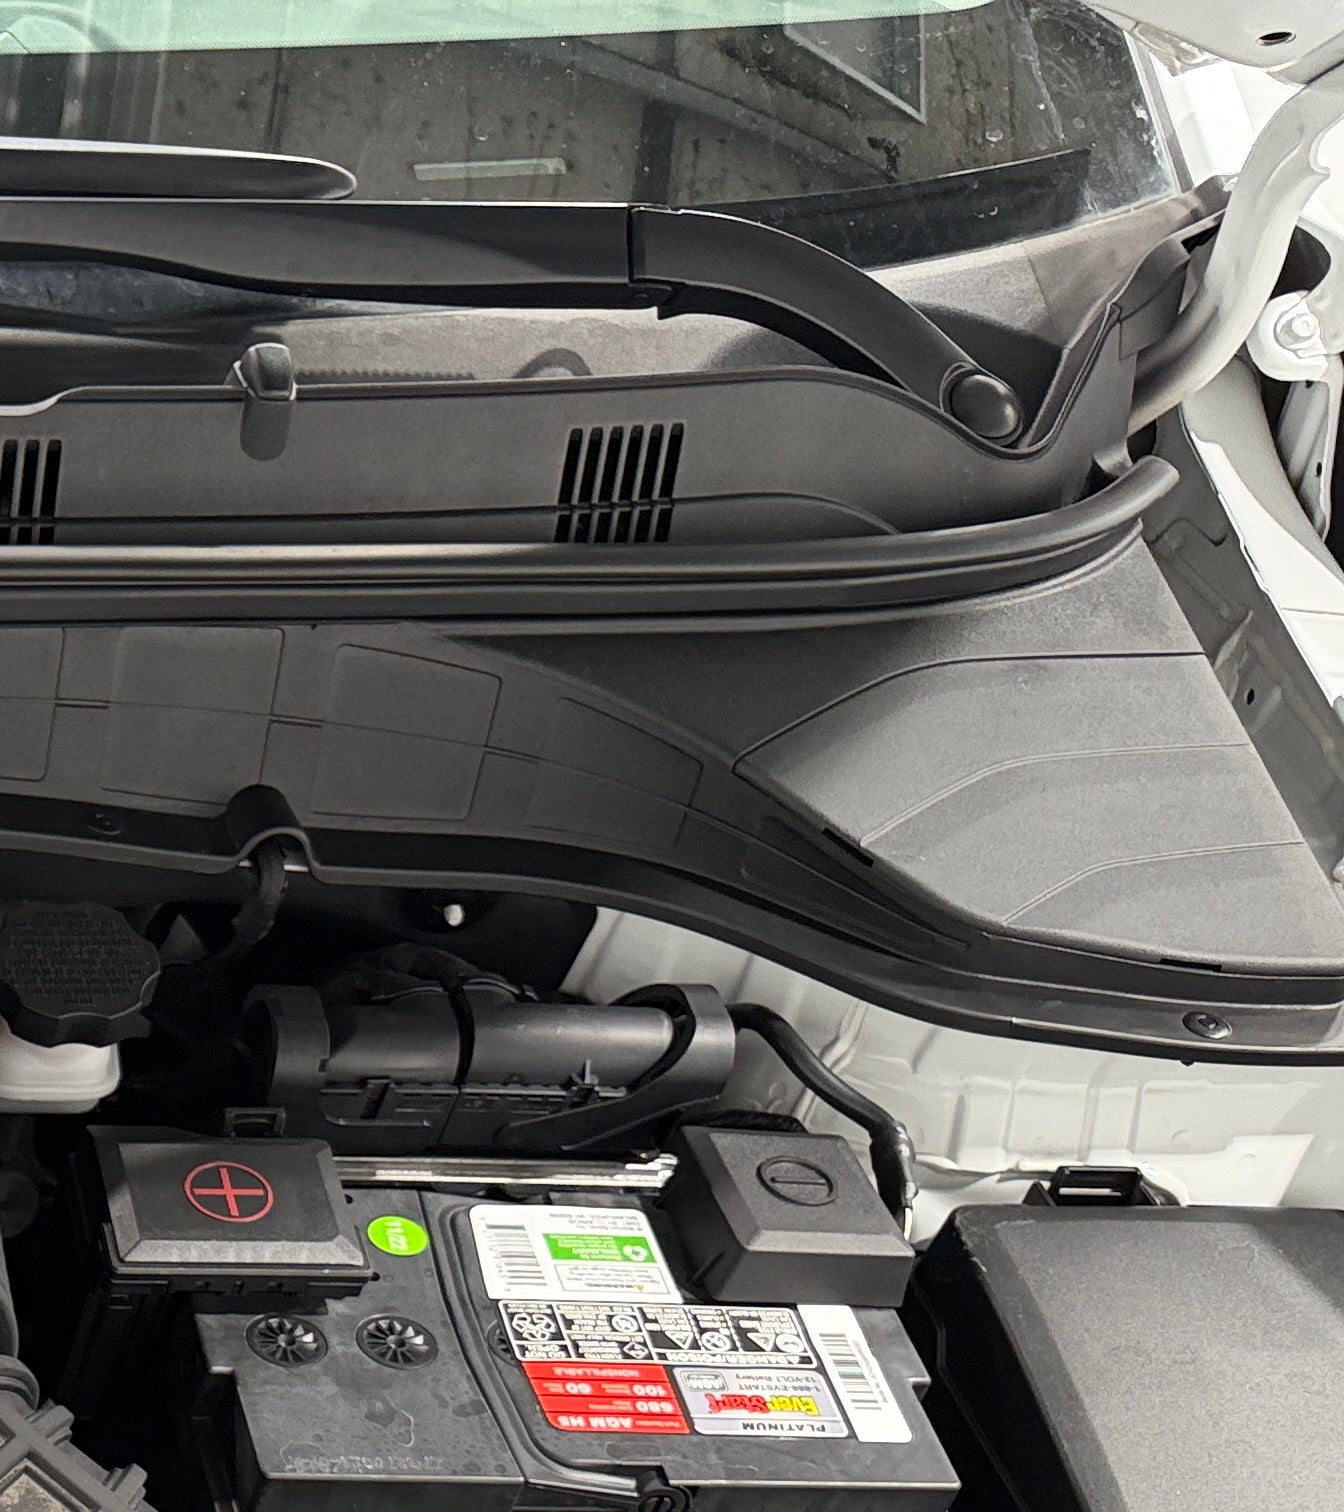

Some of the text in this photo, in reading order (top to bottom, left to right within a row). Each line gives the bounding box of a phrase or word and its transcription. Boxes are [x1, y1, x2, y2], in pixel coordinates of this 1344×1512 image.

[553, 1367, 640, 1378] NONSPILLABLE
[564, 1382, 593, 1395] 60
[633, 1384, 668, 1397] 100
[634, 1400, 675, 1413] 680
[705, 1394, 821, 1417] EverStart
[588, 1416, 632, 1429] AGM
[741, 1422, 827, 1433] PLATINUM
